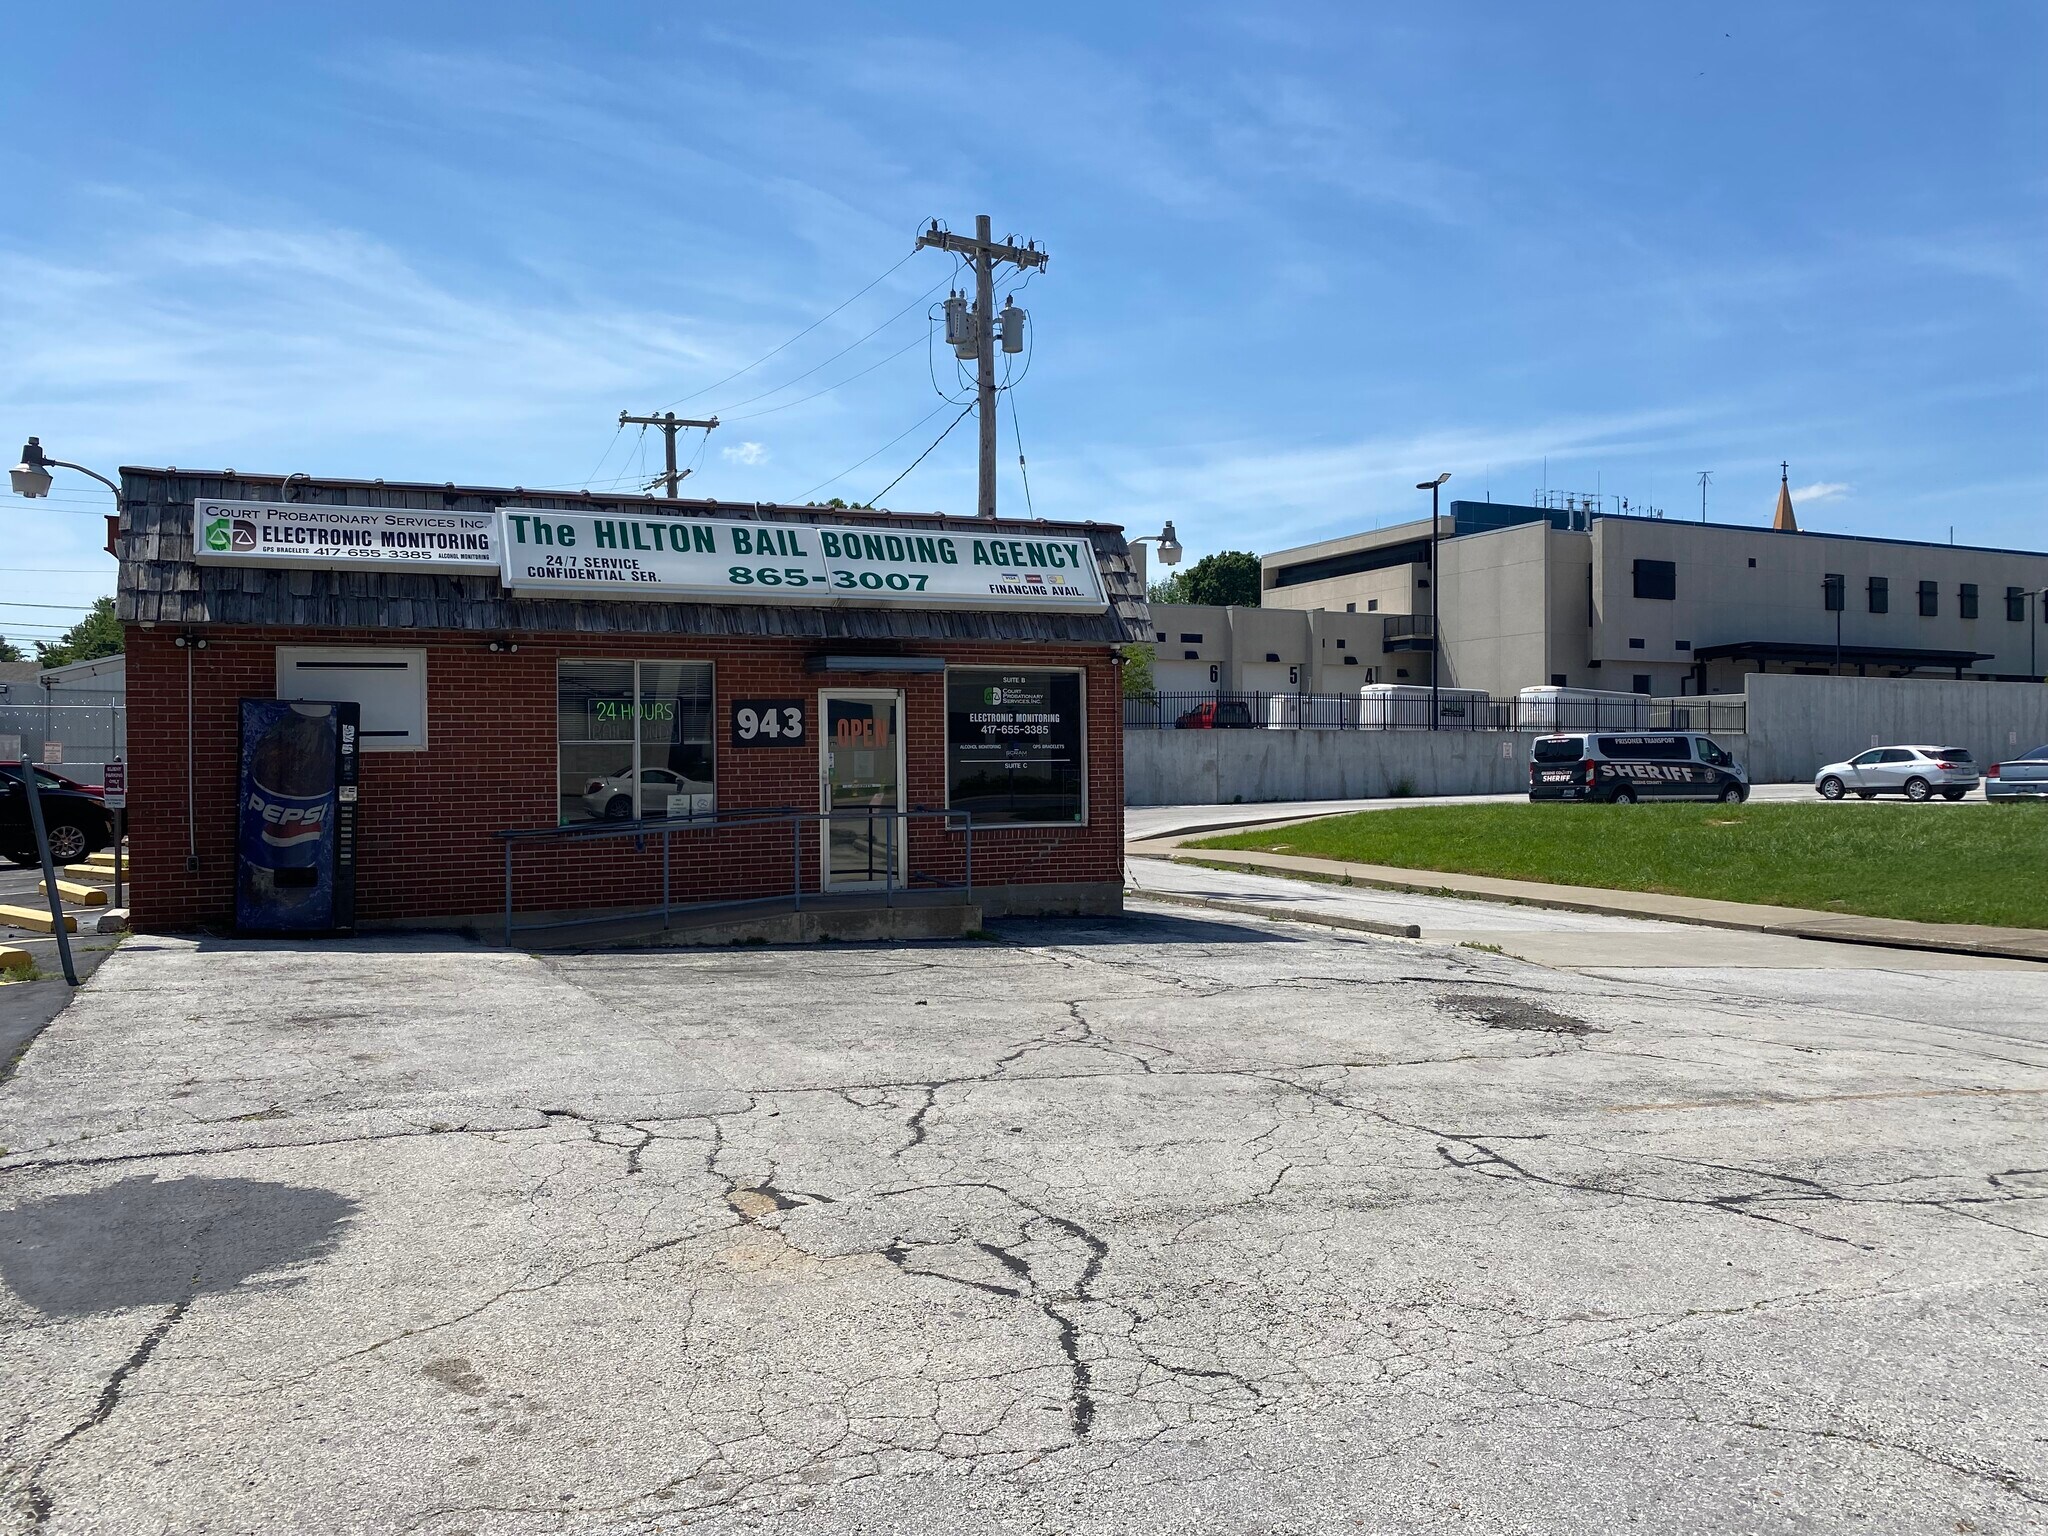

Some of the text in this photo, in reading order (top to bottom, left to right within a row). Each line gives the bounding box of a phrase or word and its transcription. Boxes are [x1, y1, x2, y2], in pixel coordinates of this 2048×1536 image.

[206, 506, 488, 529] COURT PROBATIONARY SERVICES INC.
[263, 525, 489, 550] ELECTRONIC MONITORING
[508, 515, 1080, 568] The HILTON BAIL BONDING AGENCY
[276, 546, 309, 554] BRACELETS
[314, 547, 432, 559] 417-655-3385
[546, 555, 640, 570] 24/7 SERVICE
[528, 566, 661, 583] CONFIDENTIAL SER.
[728, 566, 929, 591] 865-3007
[989, 584, 1085, 596] FINANCING AVAIL.
[1209, 664, 1219, 683] 6
[1289, 666, 1298, 684] 5
[1364, 668, 1374, 684] 4
[596, 702, 674, 722] 24 HOURS
[969, 713, 1060, 723] ELECTRONIC MONITORING
[737, 707, 803, 740] 943
[981, 725, 1049, 735] 417-655-3385
[837, 718, 888, 748] OPEN
[1600, 764, 1694, 782] SHERIFF
[248, 792, 329, 826] PEPSI
